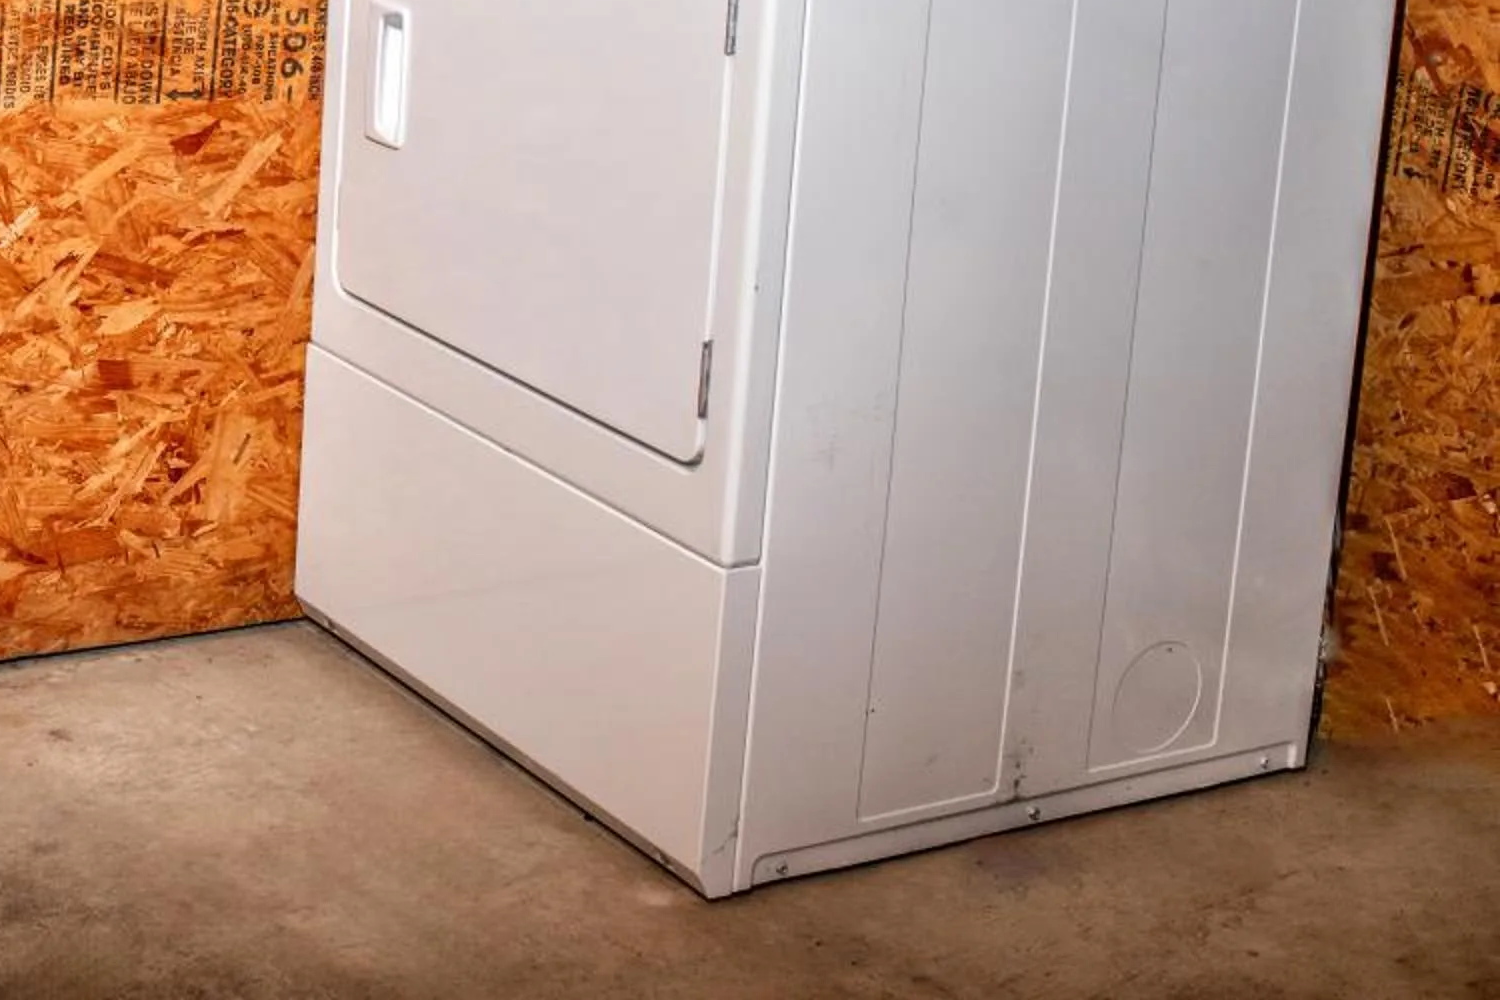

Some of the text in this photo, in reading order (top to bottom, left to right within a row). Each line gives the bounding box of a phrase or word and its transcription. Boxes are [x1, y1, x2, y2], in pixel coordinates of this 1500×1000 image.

[59, 4, 76, 86] REQUIRED
[137, 59, 154, 105] DOWN
[219, 16, 240, 99] CATEGORY
